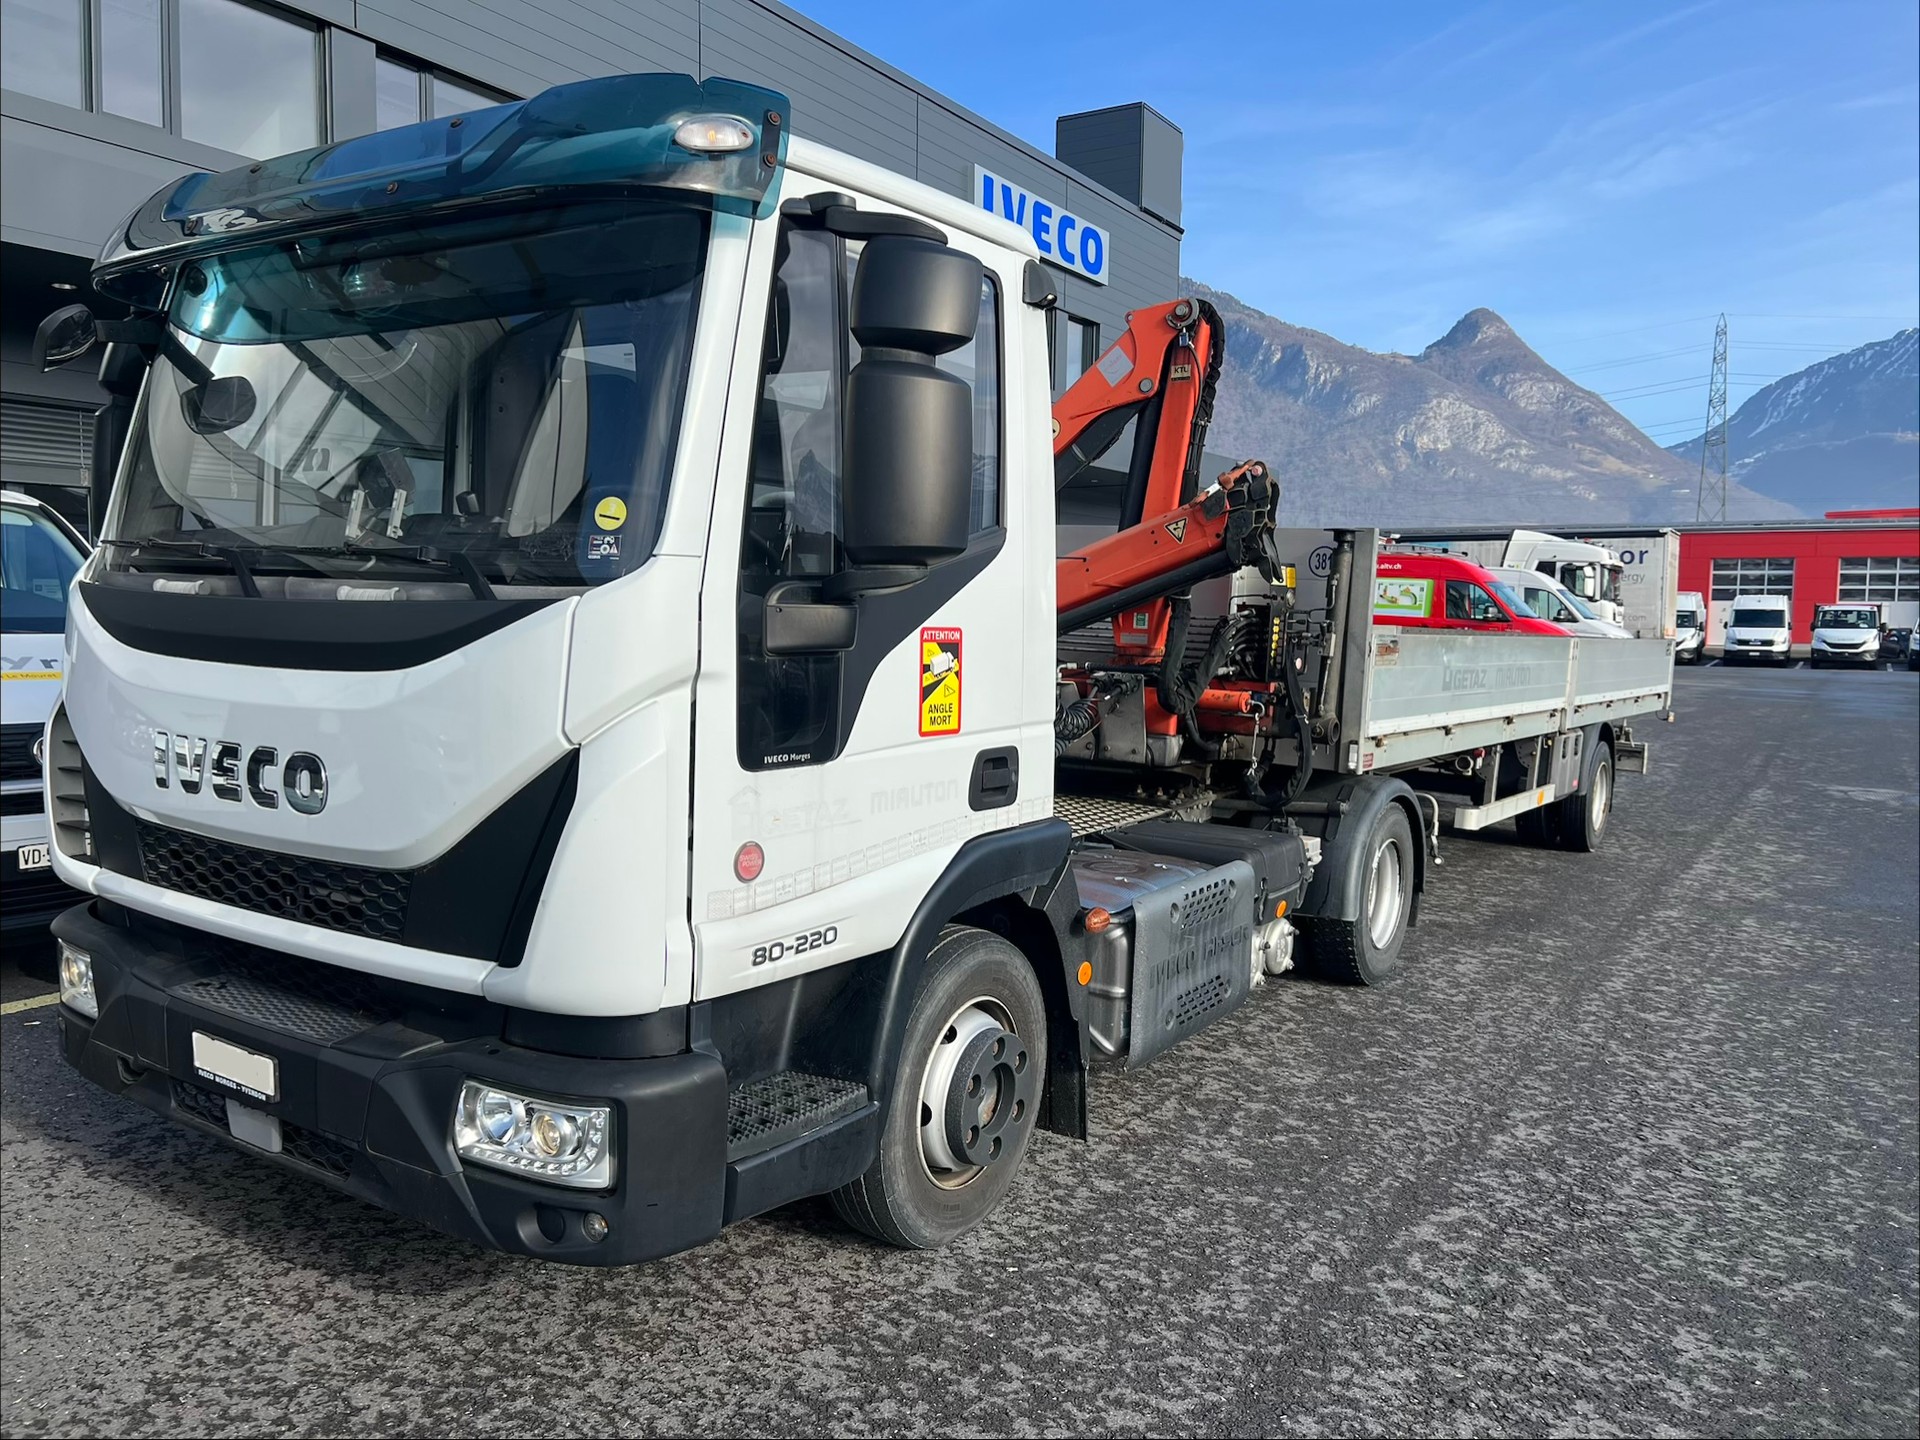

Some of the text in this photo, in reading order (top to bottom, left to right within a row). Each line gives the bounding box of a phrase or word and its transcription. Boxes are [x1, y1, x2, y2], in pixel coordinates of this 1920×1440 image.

[982, 173, 1104, 276] IVECO
[1619, 549, 1649, 565] or
[1620, 572, 1646, 584] ergy
[922, 630, 960, 641] ATTENTION
[928, 703, 954, 714] ANGLE
[929, 715, 952, 726] MORT
[764, 753, 811, 764] IVECO Morges
[153, 731, 329, 815] IVECO
[752, 925, 838, 966] 80-220
